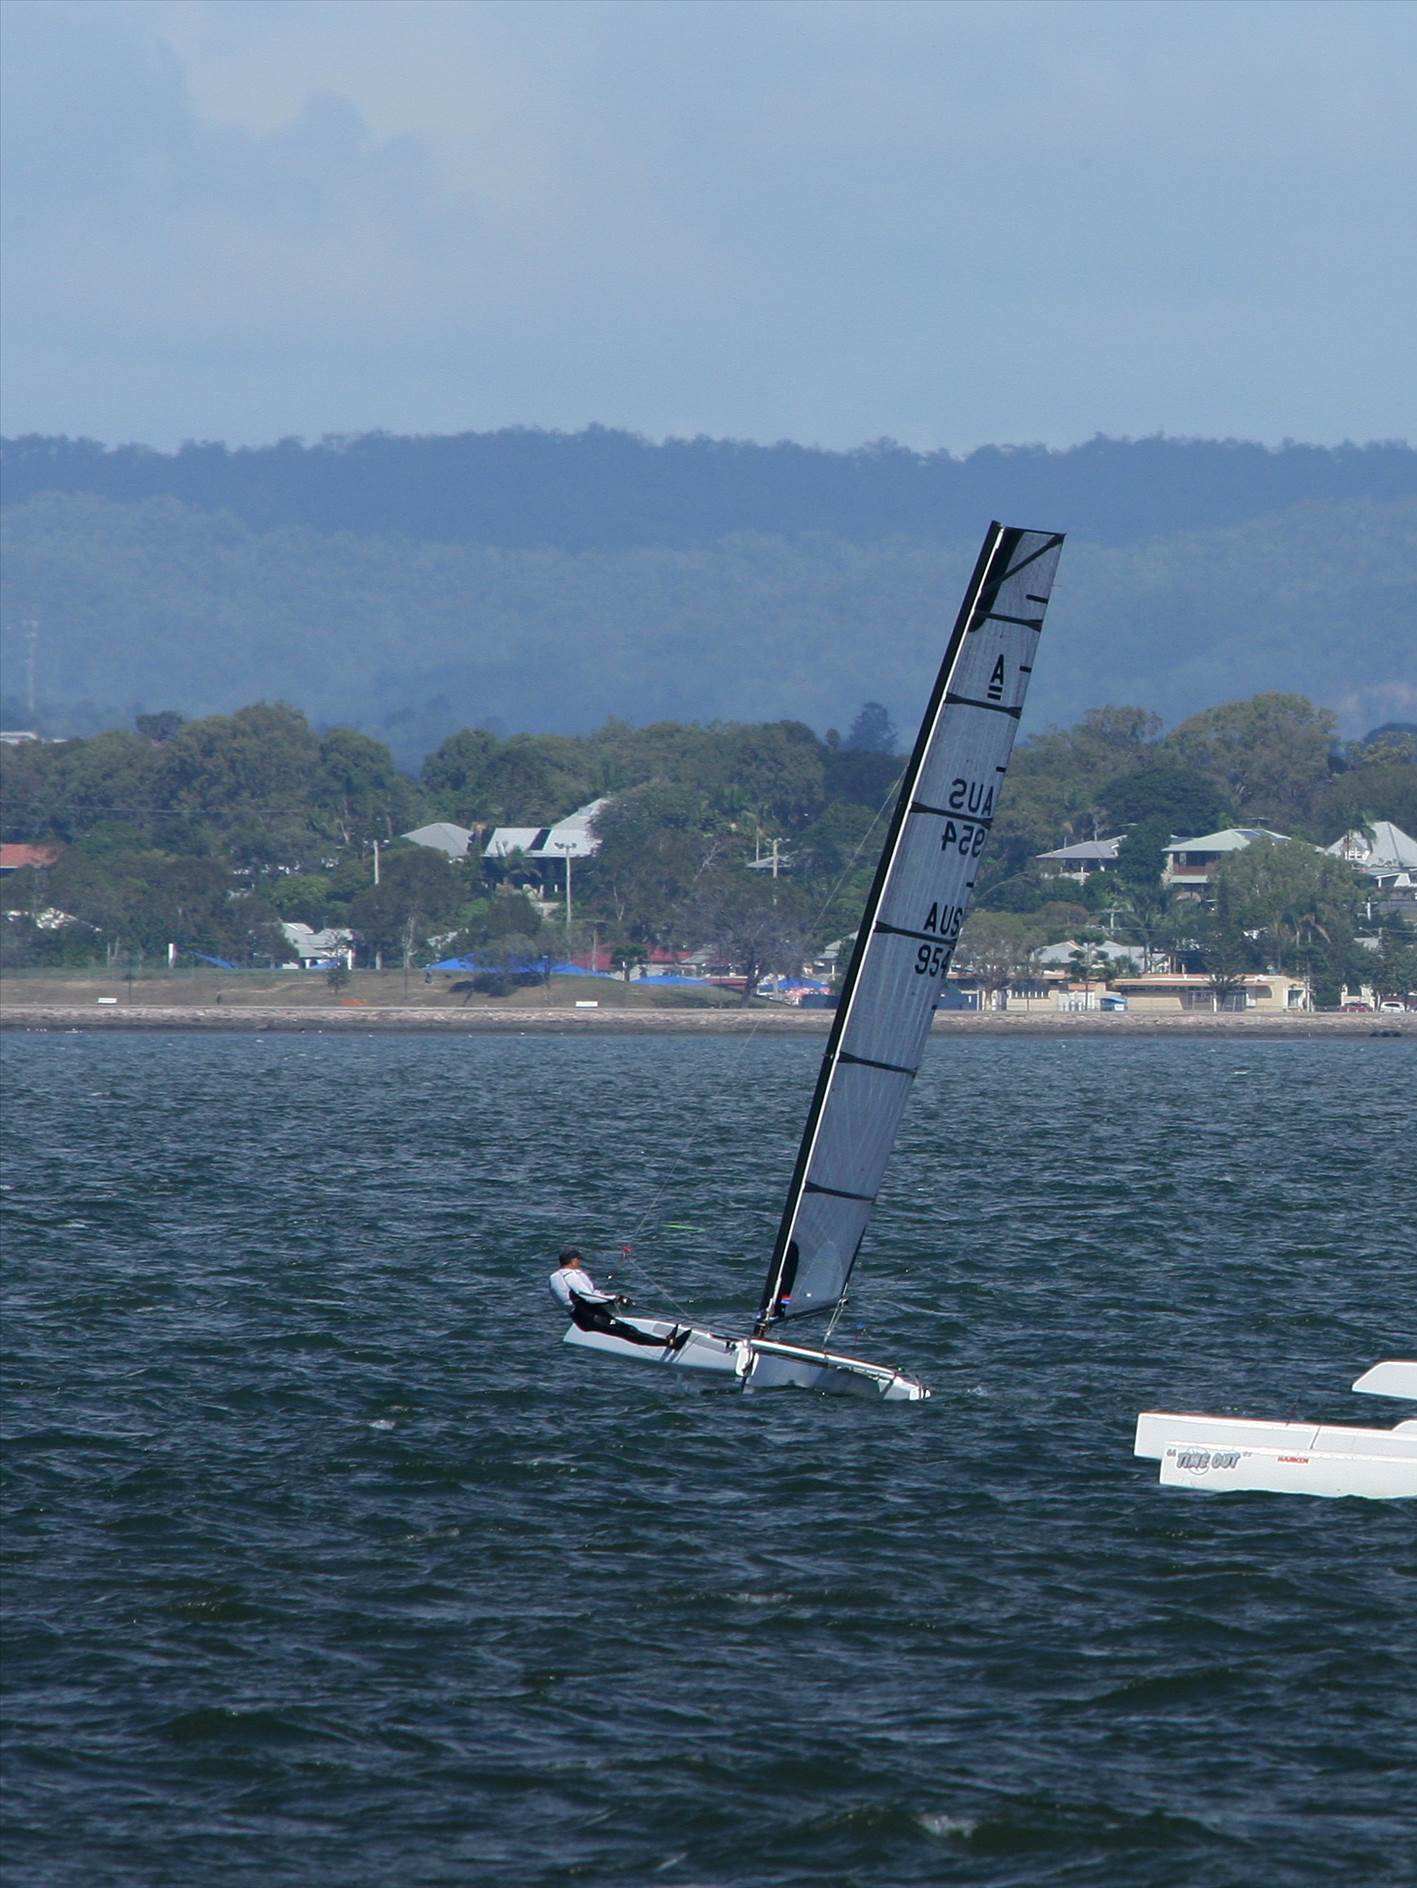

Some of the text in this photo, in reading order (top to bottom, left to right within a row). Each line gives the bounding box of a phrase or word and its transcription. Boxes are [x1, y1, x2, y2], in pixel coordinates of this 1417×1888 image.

[990, 654, 1005, 685] A
[923, 902, 963, 937] AUS
[914, 944, 952, 979] 954
